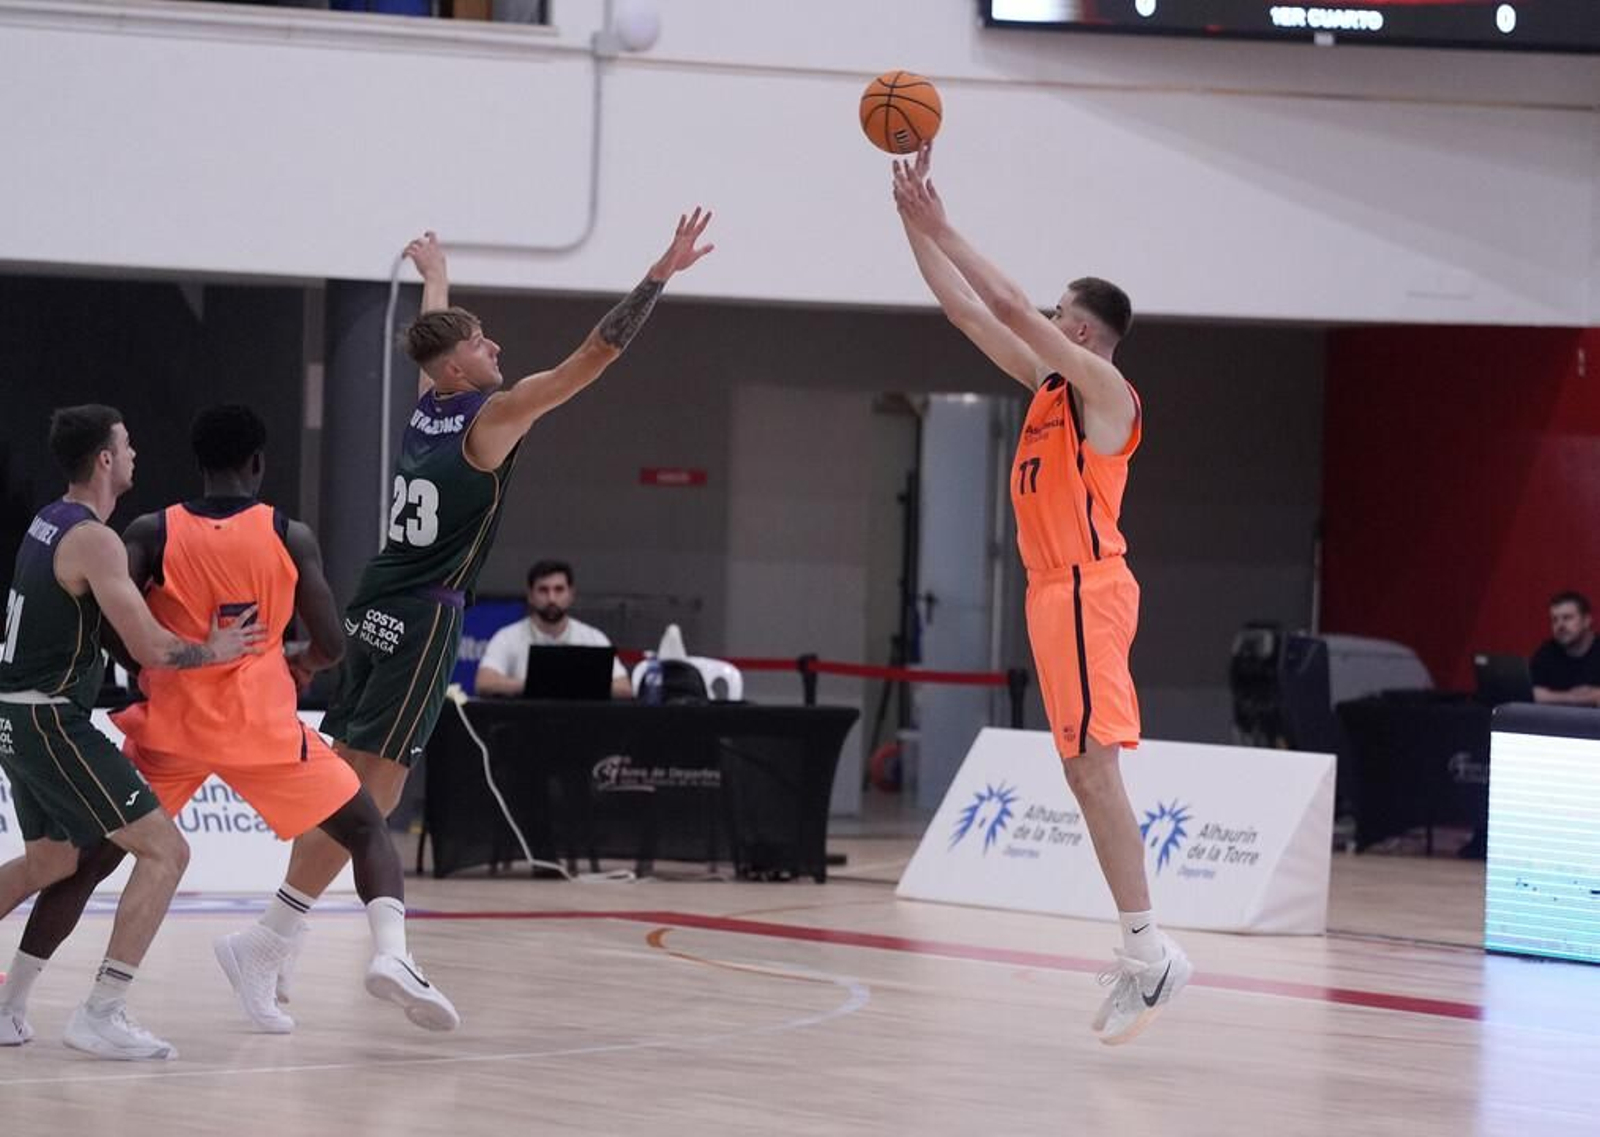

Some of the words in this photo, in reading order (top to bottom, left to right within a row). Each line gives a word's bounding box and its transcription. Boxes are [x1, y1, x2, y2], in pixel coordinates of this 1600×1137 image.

[1270, 6, 1306, 27] 1ER
[1307, 8, 1383, 30] CUARTO
[1496, 4, 1516, 33] 0
[389, 475, 439, 547] 23
[362, 620, 376, 635] DEL
[379, 627, 398, 645] SOL
[366, 609, 404, 634] COSTA
[1012, 824, 1030, 840] de
[1032, 825, 1045, 842] la
[1047, 827, 1083, 846] Torre
[1187, 845, 1206, 860] de
[1207, 845, 1221, 861] la
[1223, 845, 1260, 866] Torre
